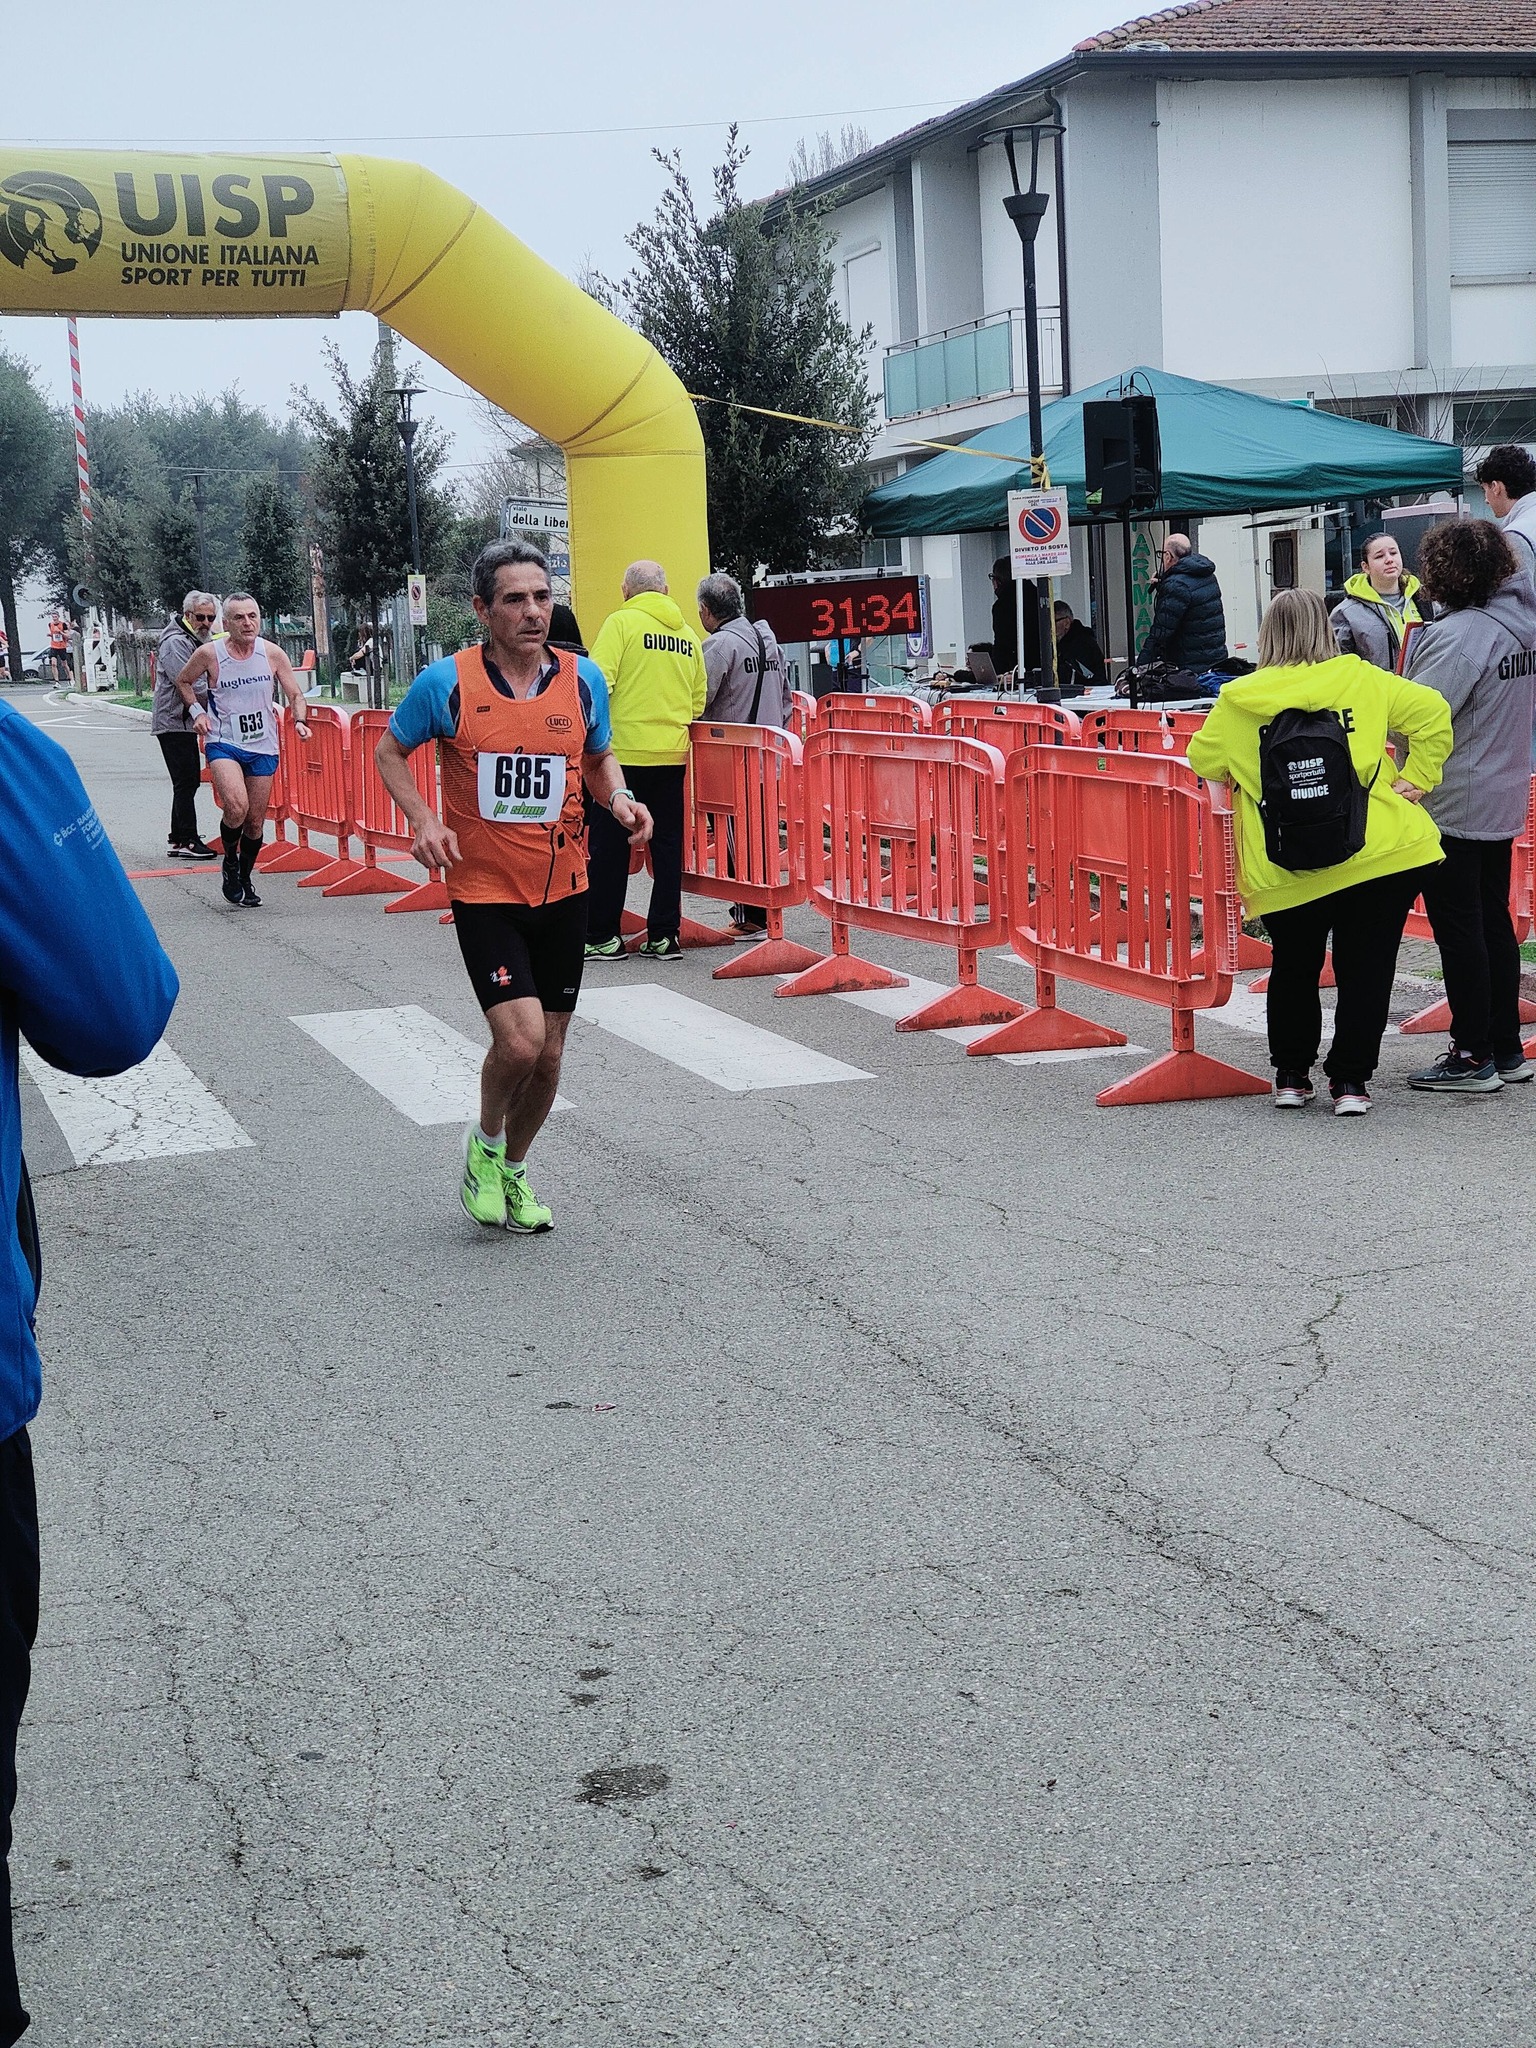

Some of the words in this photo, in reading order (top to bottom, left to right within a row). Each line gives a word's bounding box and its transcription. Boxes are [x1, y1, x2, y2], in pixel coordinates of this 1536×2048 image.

[114, 172, 315, 238] UISP
[121, 242, 209, 265] UNIONE
[220, 244, 319, 266] ITALIANA
[121, 266, 192, 286] SPORT
[201, 269, 240, 287] PER
[252, 269, 306, 287] TUTTI
[512, 513, 539, 526] della
[811, 592, 918, 637] 31:34
[644, 633, 693, 657] GIUDICE
[239, 711, 264, 733] 633
[549, 717, 569, 726] LUCCI
[1296, 757, 1324, 770] UISP
[494, 756, 551, 800] 685
[1291, 784, 1330, 799] GIUDICE
[60, 823, 77, 838] BCC
